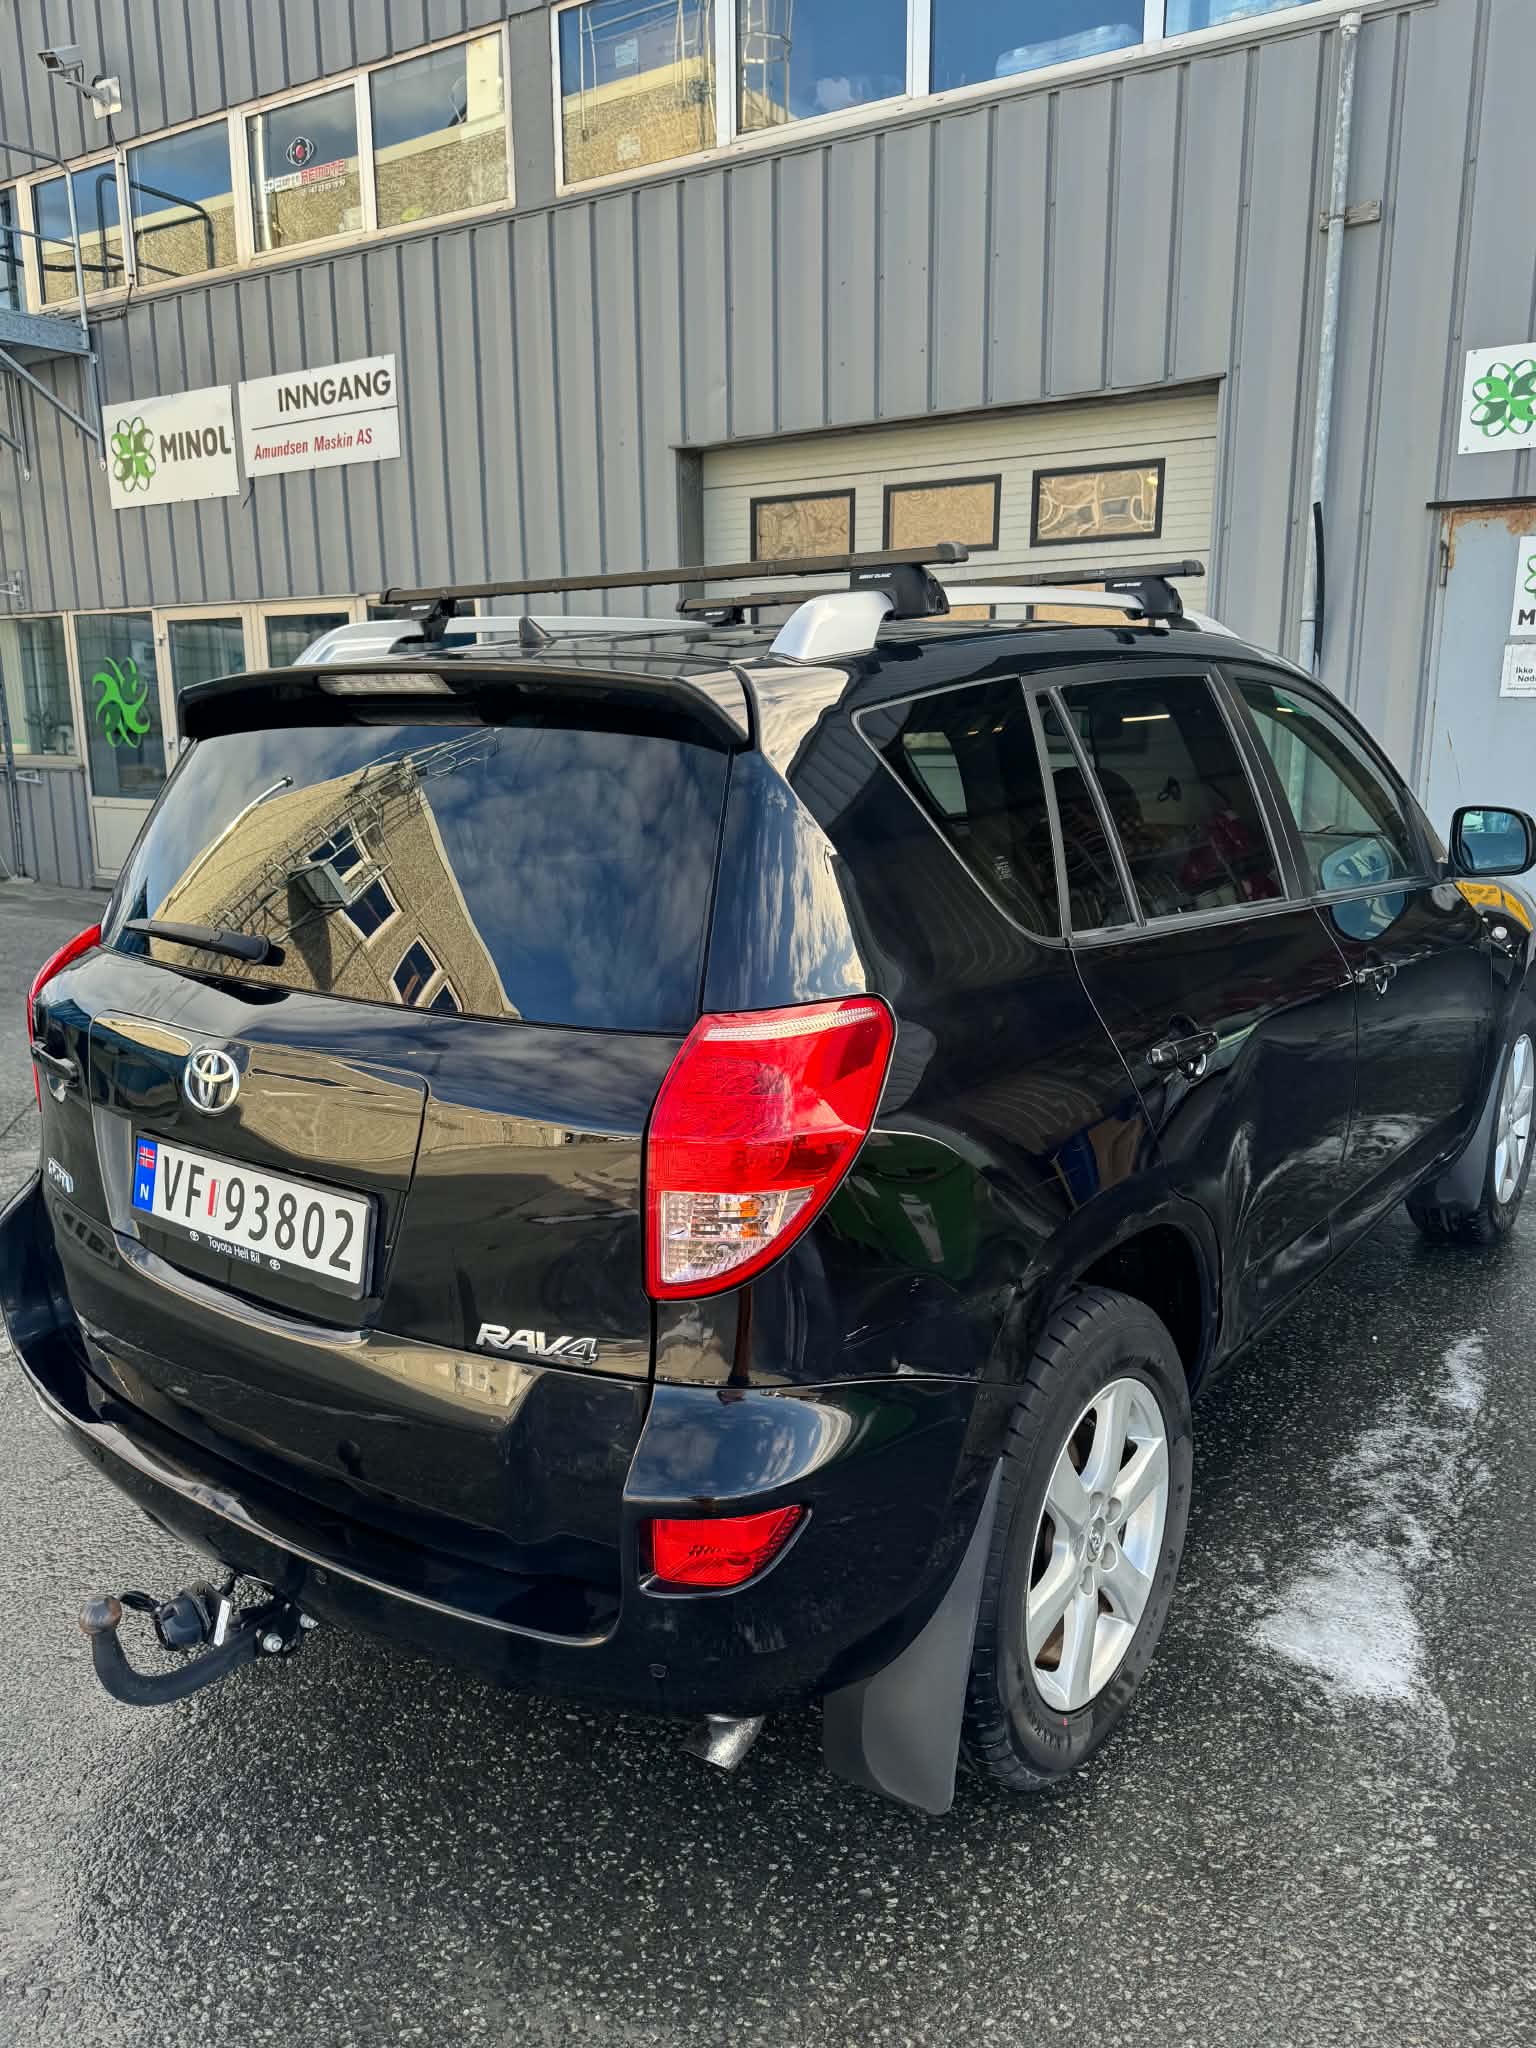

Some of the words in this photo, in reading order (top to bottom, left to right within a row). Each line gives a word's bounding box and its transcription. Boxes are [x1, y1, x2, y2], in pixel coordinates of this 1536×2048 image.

[277, 369, 391, 413] INNGANG
[159, 425, 232, 463] MINOL
[254, 439, 309, 461] Amundsen
[314, 432, 353, 453] Maskin
[356, 427, 373, 445] AS
[1517, 608, 1536, 626] M
[139, 1183, 150, 1201] N
[224, 1177, 354, 1272] 93802
[207, 1235, 233, 1254] Toyota
[250, 1250, 261, 1264] Bil
[476, 1323, 598, 1364] RAV4
